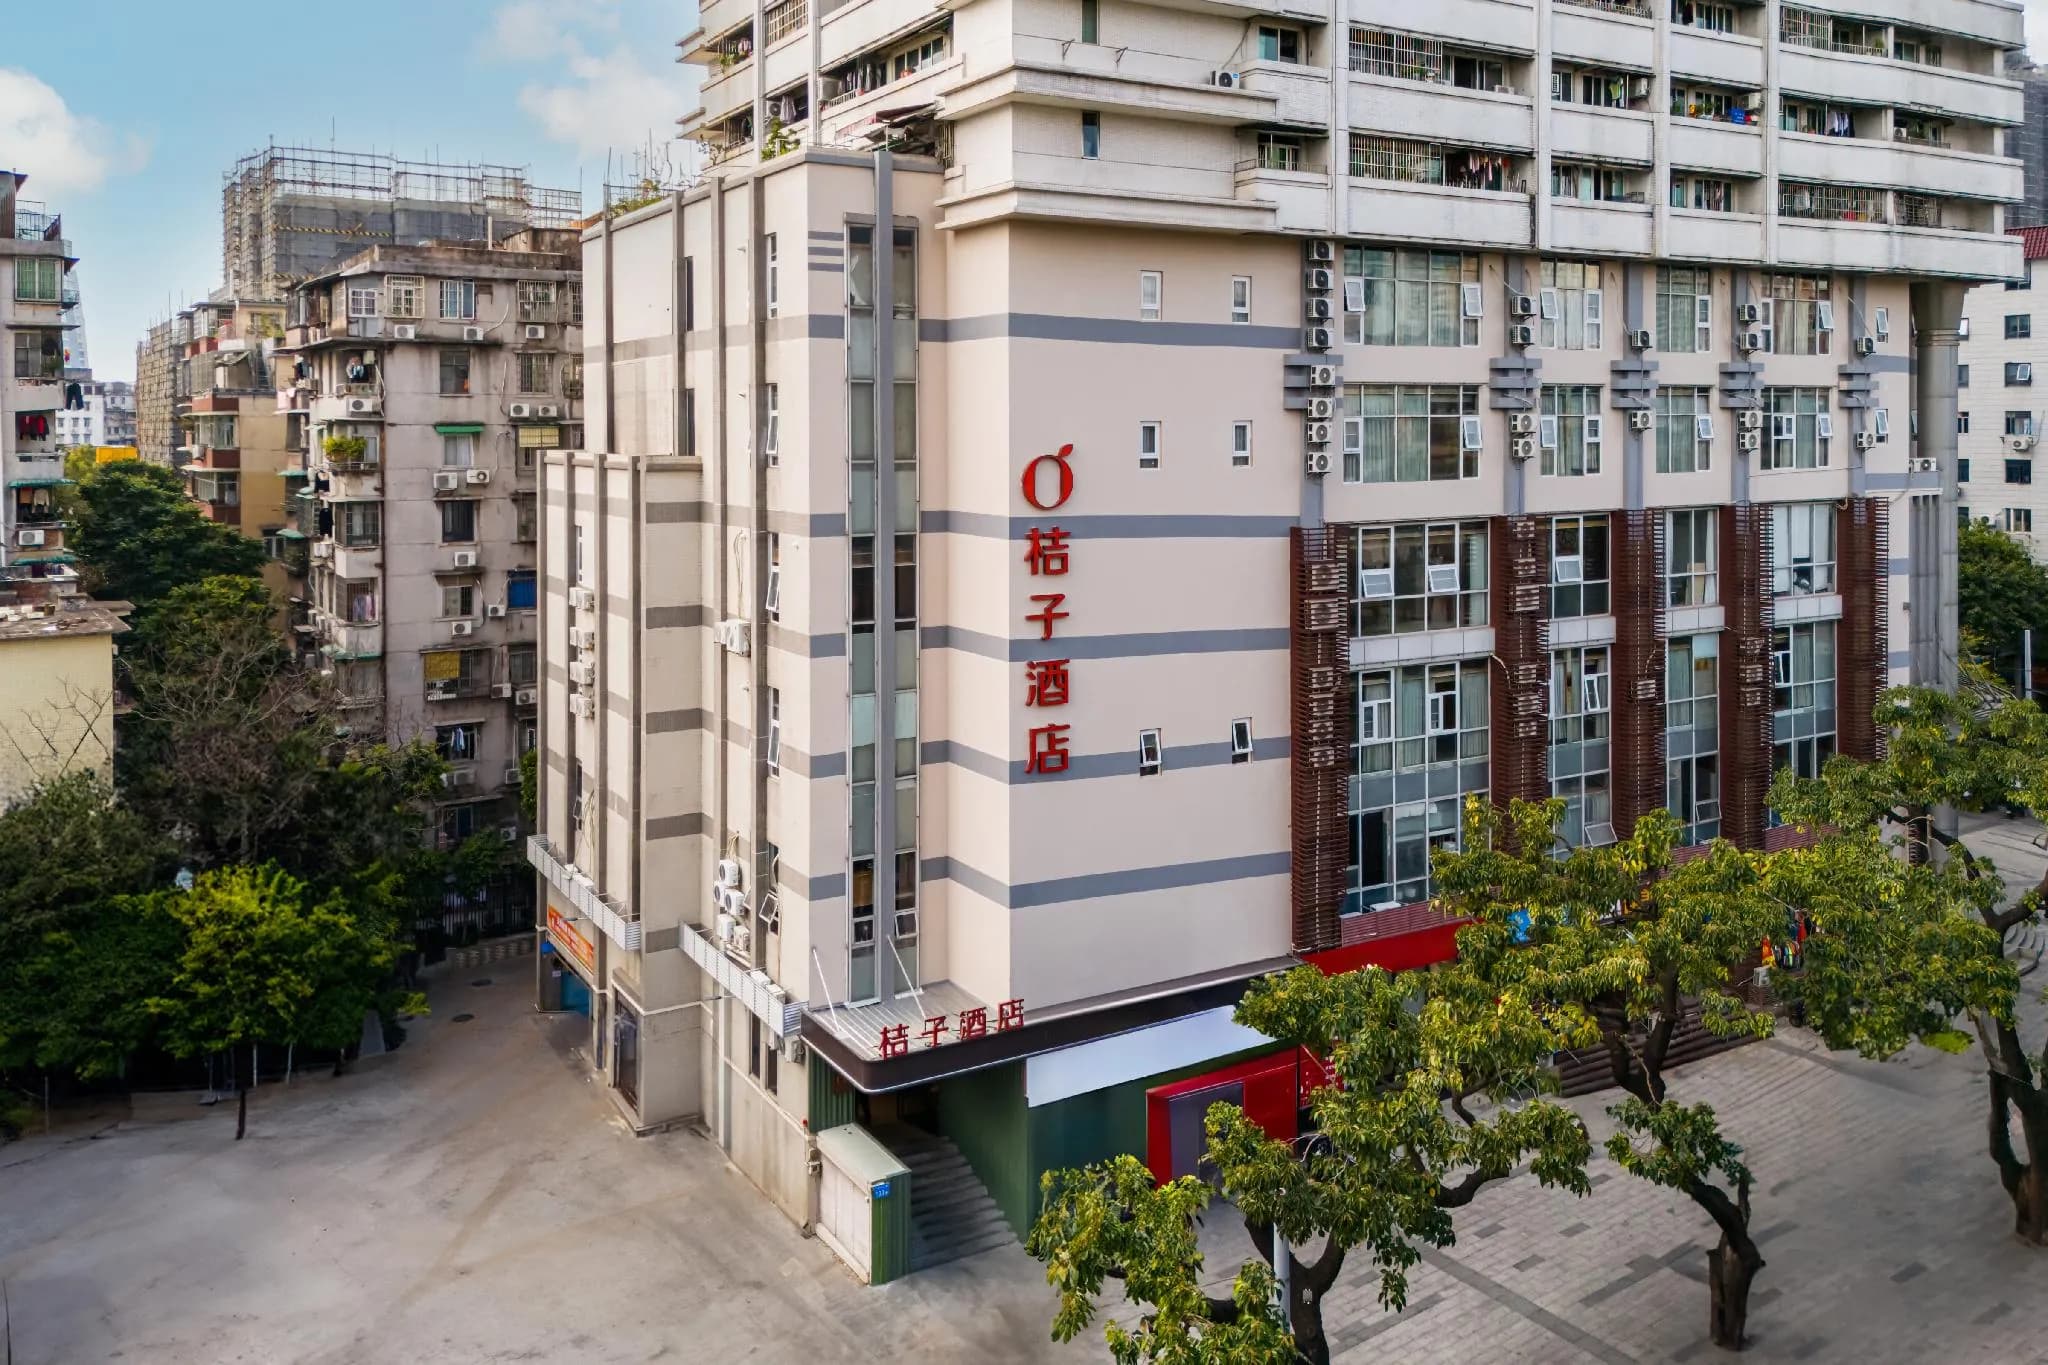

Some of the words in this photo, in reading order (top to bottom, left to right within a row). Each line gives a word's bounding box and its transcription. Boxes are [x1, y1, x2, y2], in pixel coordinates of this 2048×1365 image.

[1023, 526, 1071, 774] 桔子酒店
[879, 999, 1024, 1061] 桔子酒店
